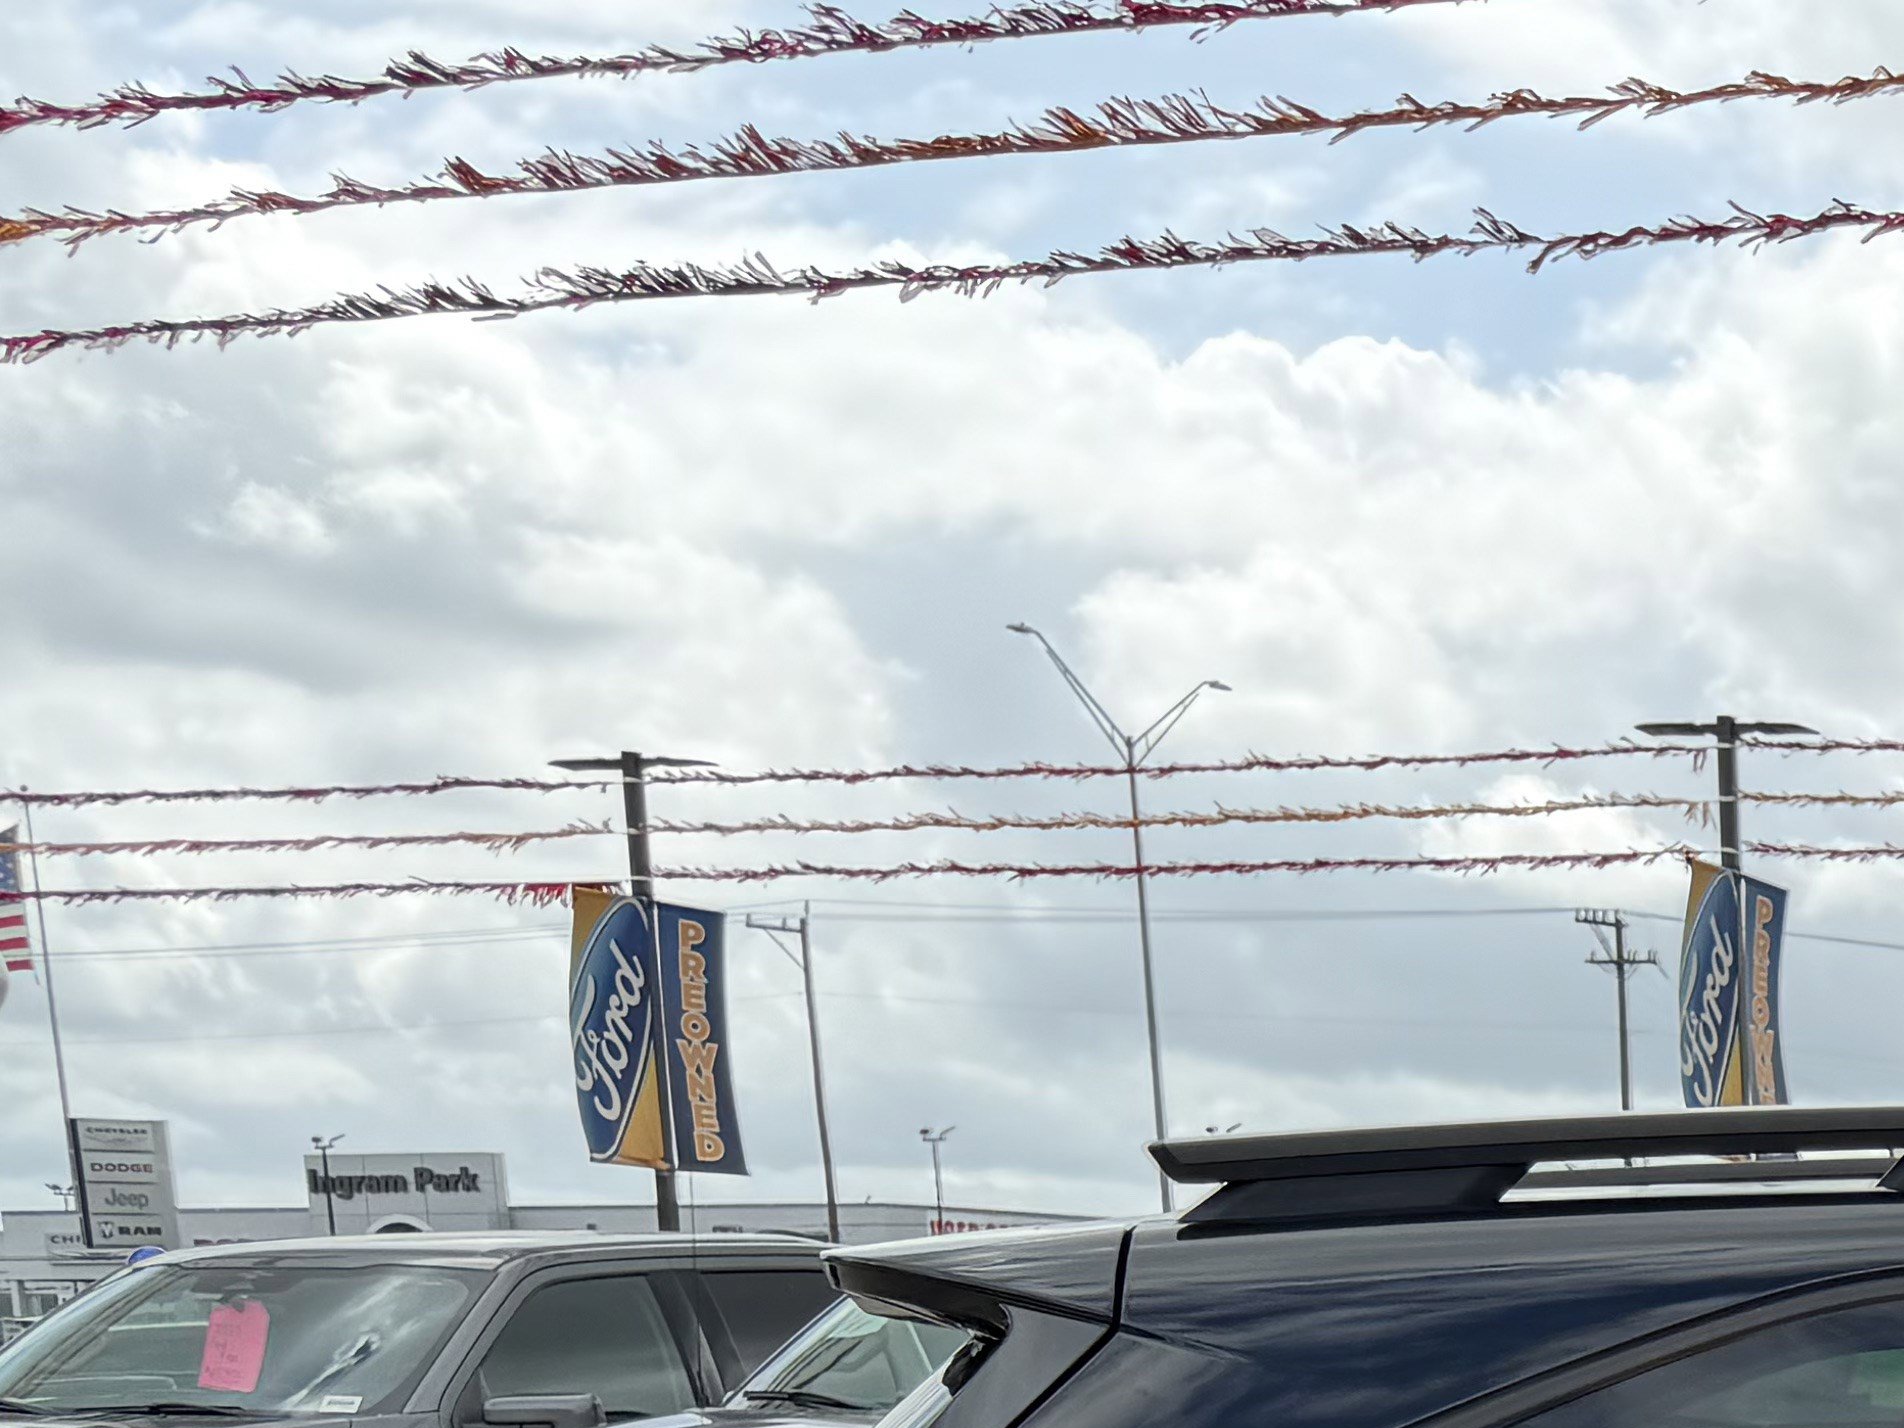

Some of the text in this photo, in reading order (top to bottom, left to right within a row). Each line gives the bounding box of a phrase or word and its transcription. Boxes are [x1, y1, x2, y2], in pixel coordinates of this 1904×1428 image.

[1680, 913, 1734, 1107] Ford
[574, 938, 646, 1121] Ford
[676, 918, 725, 1162] PREOWNED
[90, 1162, 153, 1173] DODGE
[307, 1166, 480, 1201] Ingram Park
[104, 1187, 149, 1210] Jeep
[118, 1226, 162, 1236] RAM
